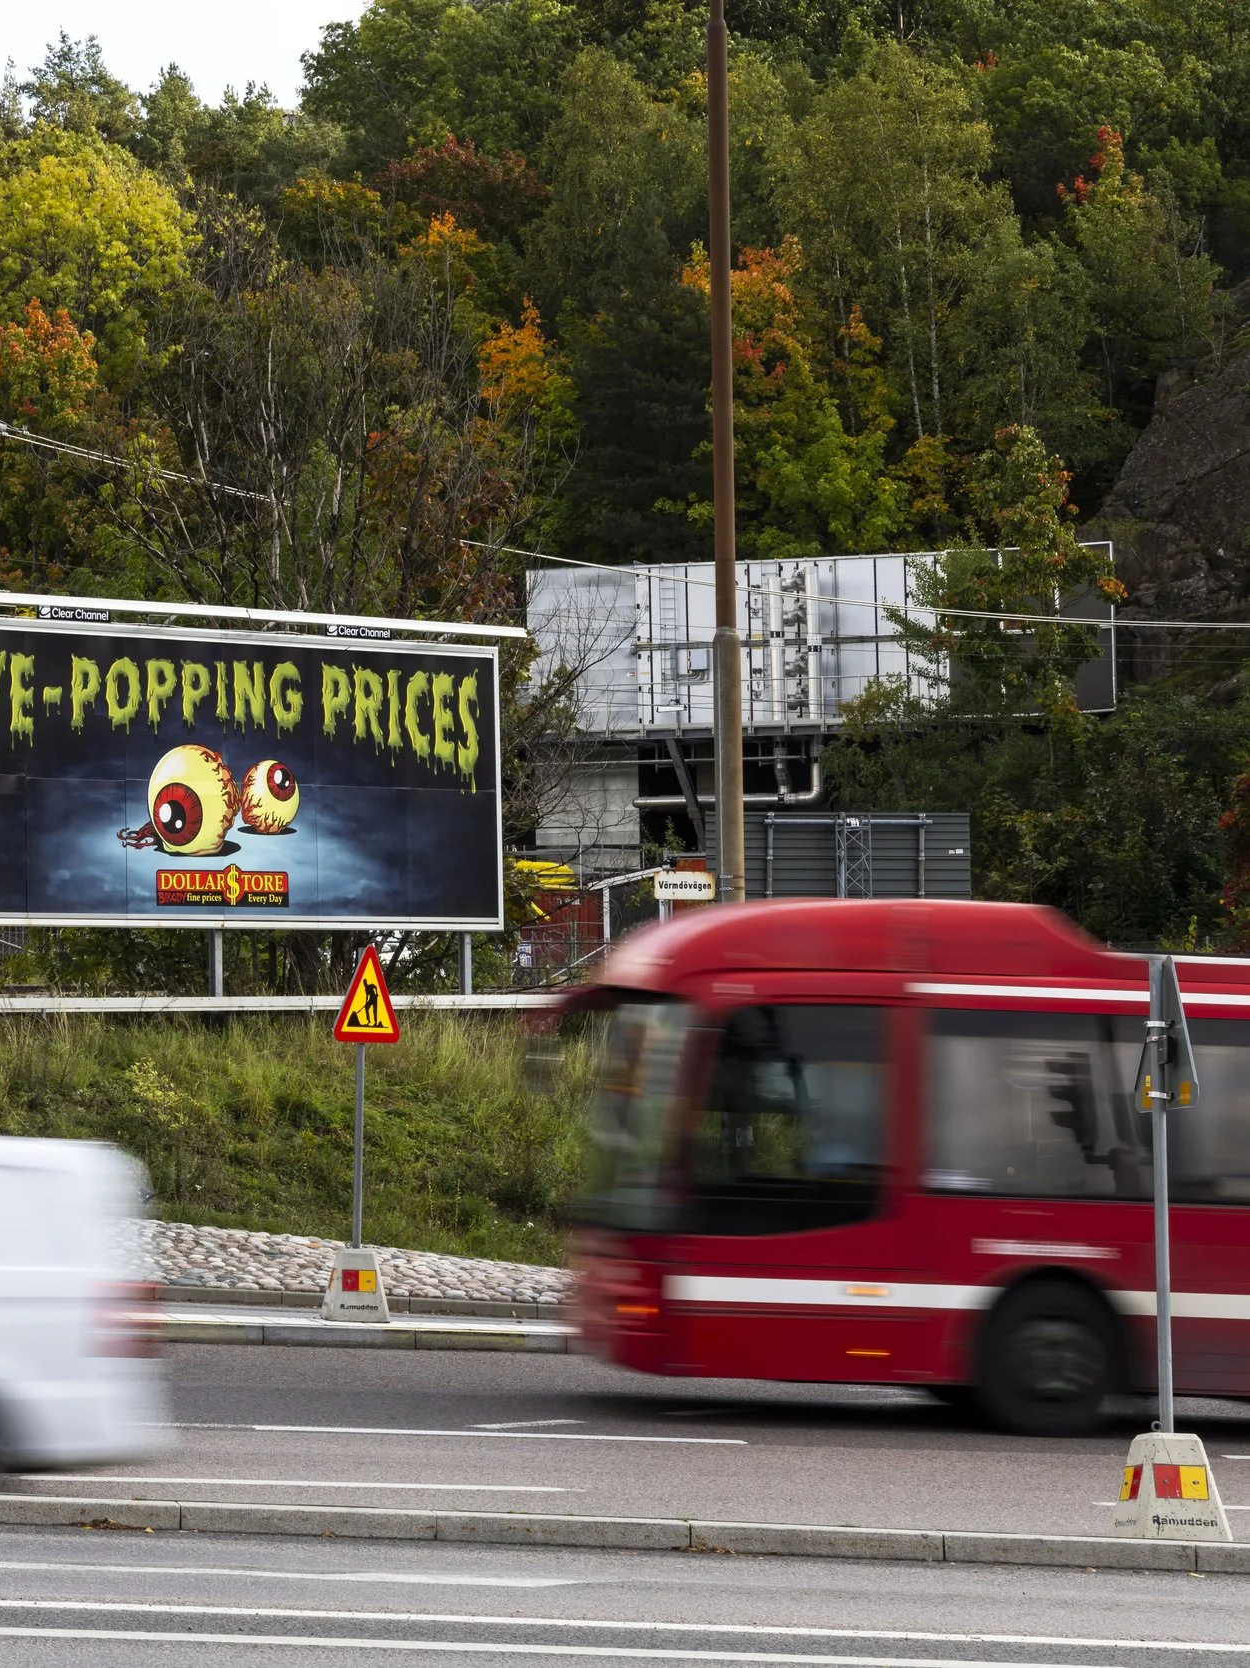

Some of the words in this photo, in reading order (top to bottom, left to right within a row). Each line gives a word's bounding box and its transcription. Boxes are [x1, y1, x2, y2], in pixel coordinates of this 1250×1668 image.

[51, 607, 74, 619] Clear
[75, 609, 109, 621] Channel
[338, 625, 358, 637] Clear
[359, 627, 391, 639] Channel
[321, 661, 480, 794] PRICES
[658, 880, 712, 892] Värmdövägen
[187, 892, 201, 902] fine
[201, 892, 222, 904] prices
[248, 893, 267, 905] Every
[268, 894, 283, 906] Day
[1152, 1514, 1218, 1528] Ramudden
